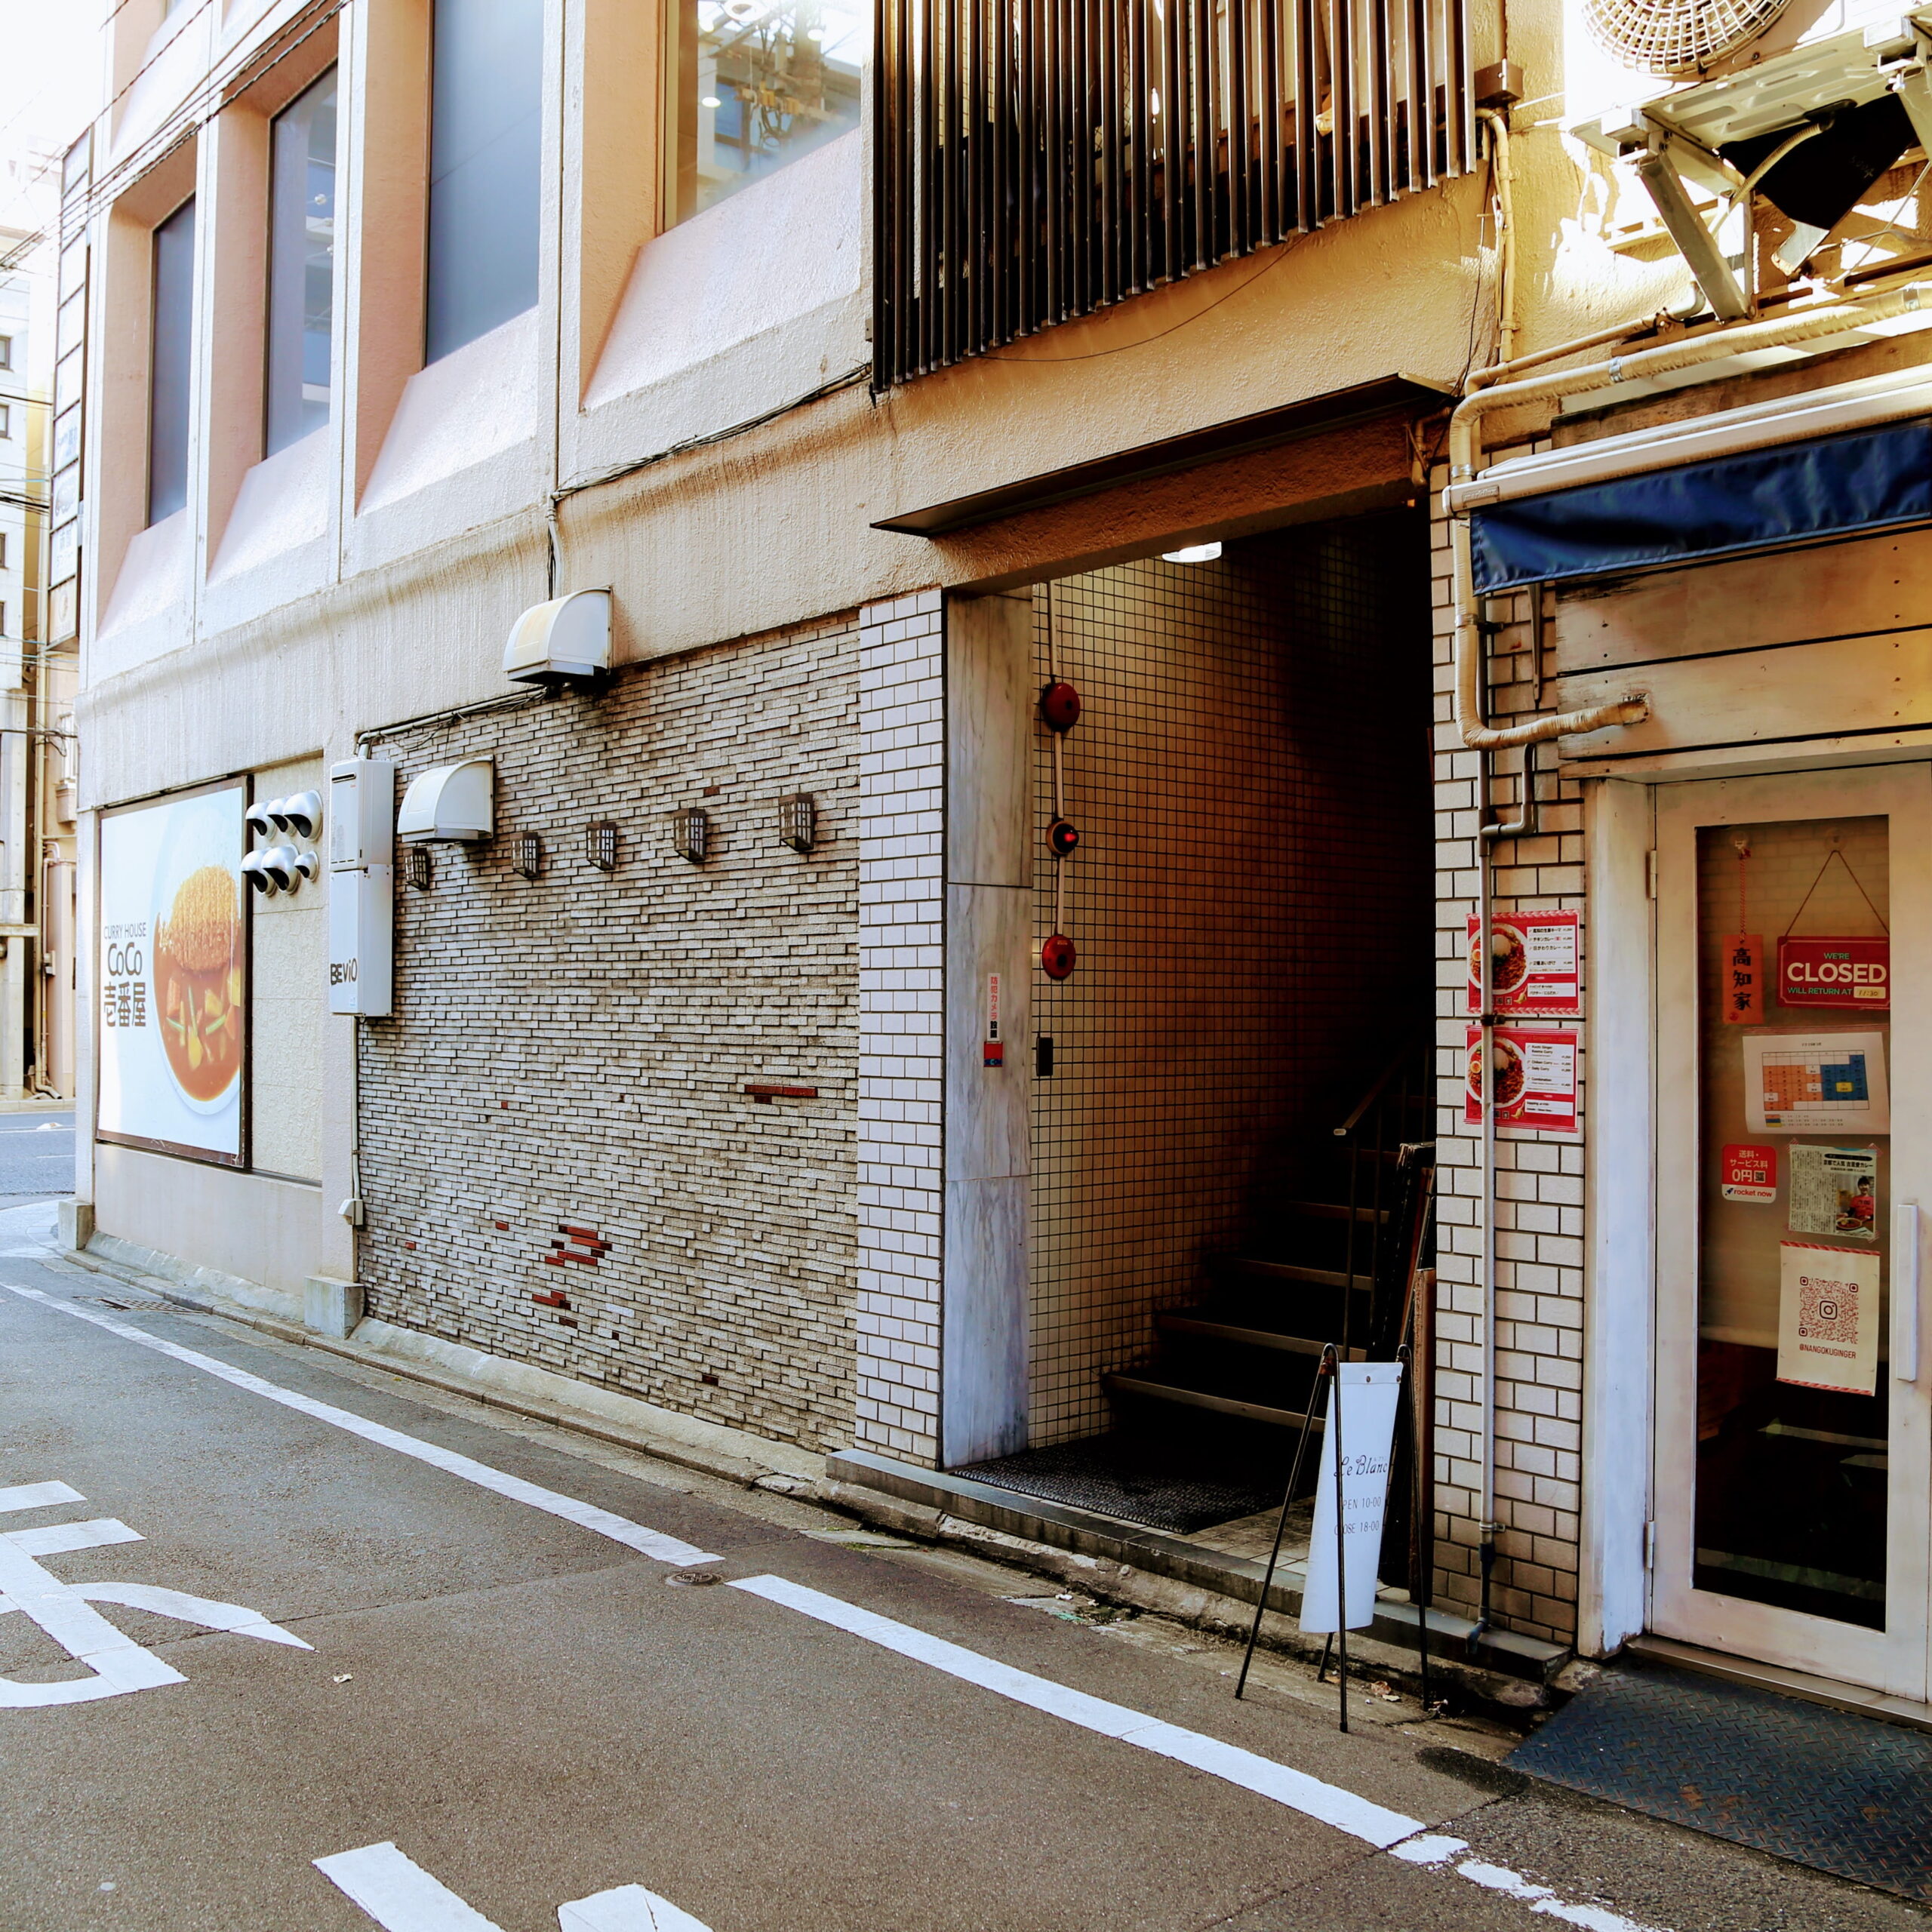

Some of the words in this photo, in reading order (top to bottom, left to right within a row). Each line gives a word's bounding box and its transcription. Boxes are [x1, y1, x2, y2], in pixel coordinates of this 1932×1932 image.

[103, 924, 122, 940] CURRY
[125, 922, 146, 937] HOUSE
[107, 942, 143, 976] CoCo
[1732, 947, 1752, 1011] 高知家
[1787, 962, 1887, 983] CLOSED
[103, 981, 146, 1027] 壱番屋
[1730, 1158, 1768, 1169] サービス料
[1732, 1168, 1752, 1182] 0円
[1799, 1343, 1857, 1358] @NANGOKUGINGER
[1355, 1454, 1388, 1475] Blanc
[1342, 1498, 1358, 1509] PEN
[1362, 1497, 1381, 1508] 10-00
[1334, 1523, 1356, 1536] COSE
[1360, 1520, 1380, 1532] 18-00
